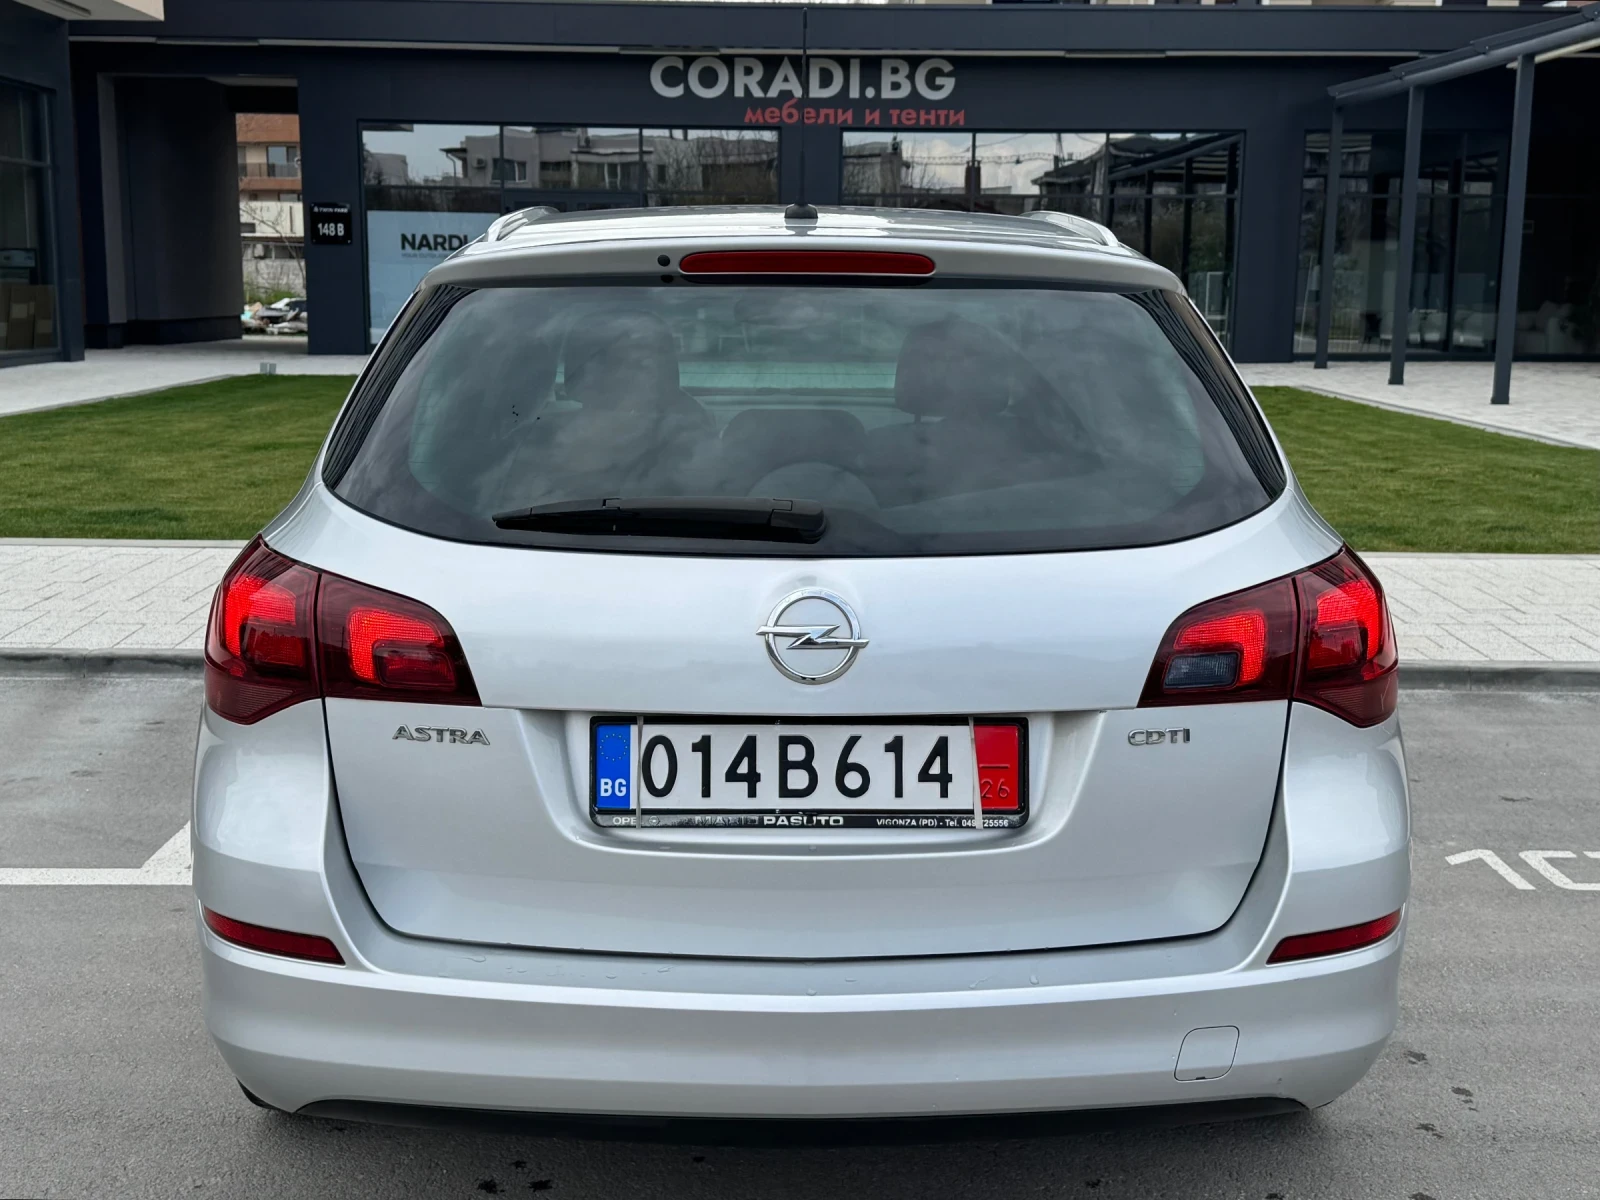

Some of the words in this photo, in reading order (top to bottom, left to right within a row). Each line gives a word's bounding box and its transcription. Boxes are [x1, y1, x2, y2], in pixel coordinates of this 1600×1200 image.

[650, 56, 956, 101] CORADI.BG
[744, 98, 853, 125] мебели
[865, 109, 881, 125] и
[889, 109, 965, 126] тенти
[317, 222, 336, 236] 148
[337, 222, 345, 236] B
[400, 233, 468, 251] NARDI
[392, 723, 491, 746] ASTRA
[1128, 726, 1191, 746] CDTI
[599, 777, 627, 797] BG
[980, 777, 1010, 798] 26
[612, 816, 644, 826] OPE
[763, 815, 844, 826] PASUTO
[876, 818, 917, 827] VIGONZA
[918, 818, 938, 828] (PD)
[944, 818, 960, 827] Tel.
[981, 818, 1009, 828] 25556
